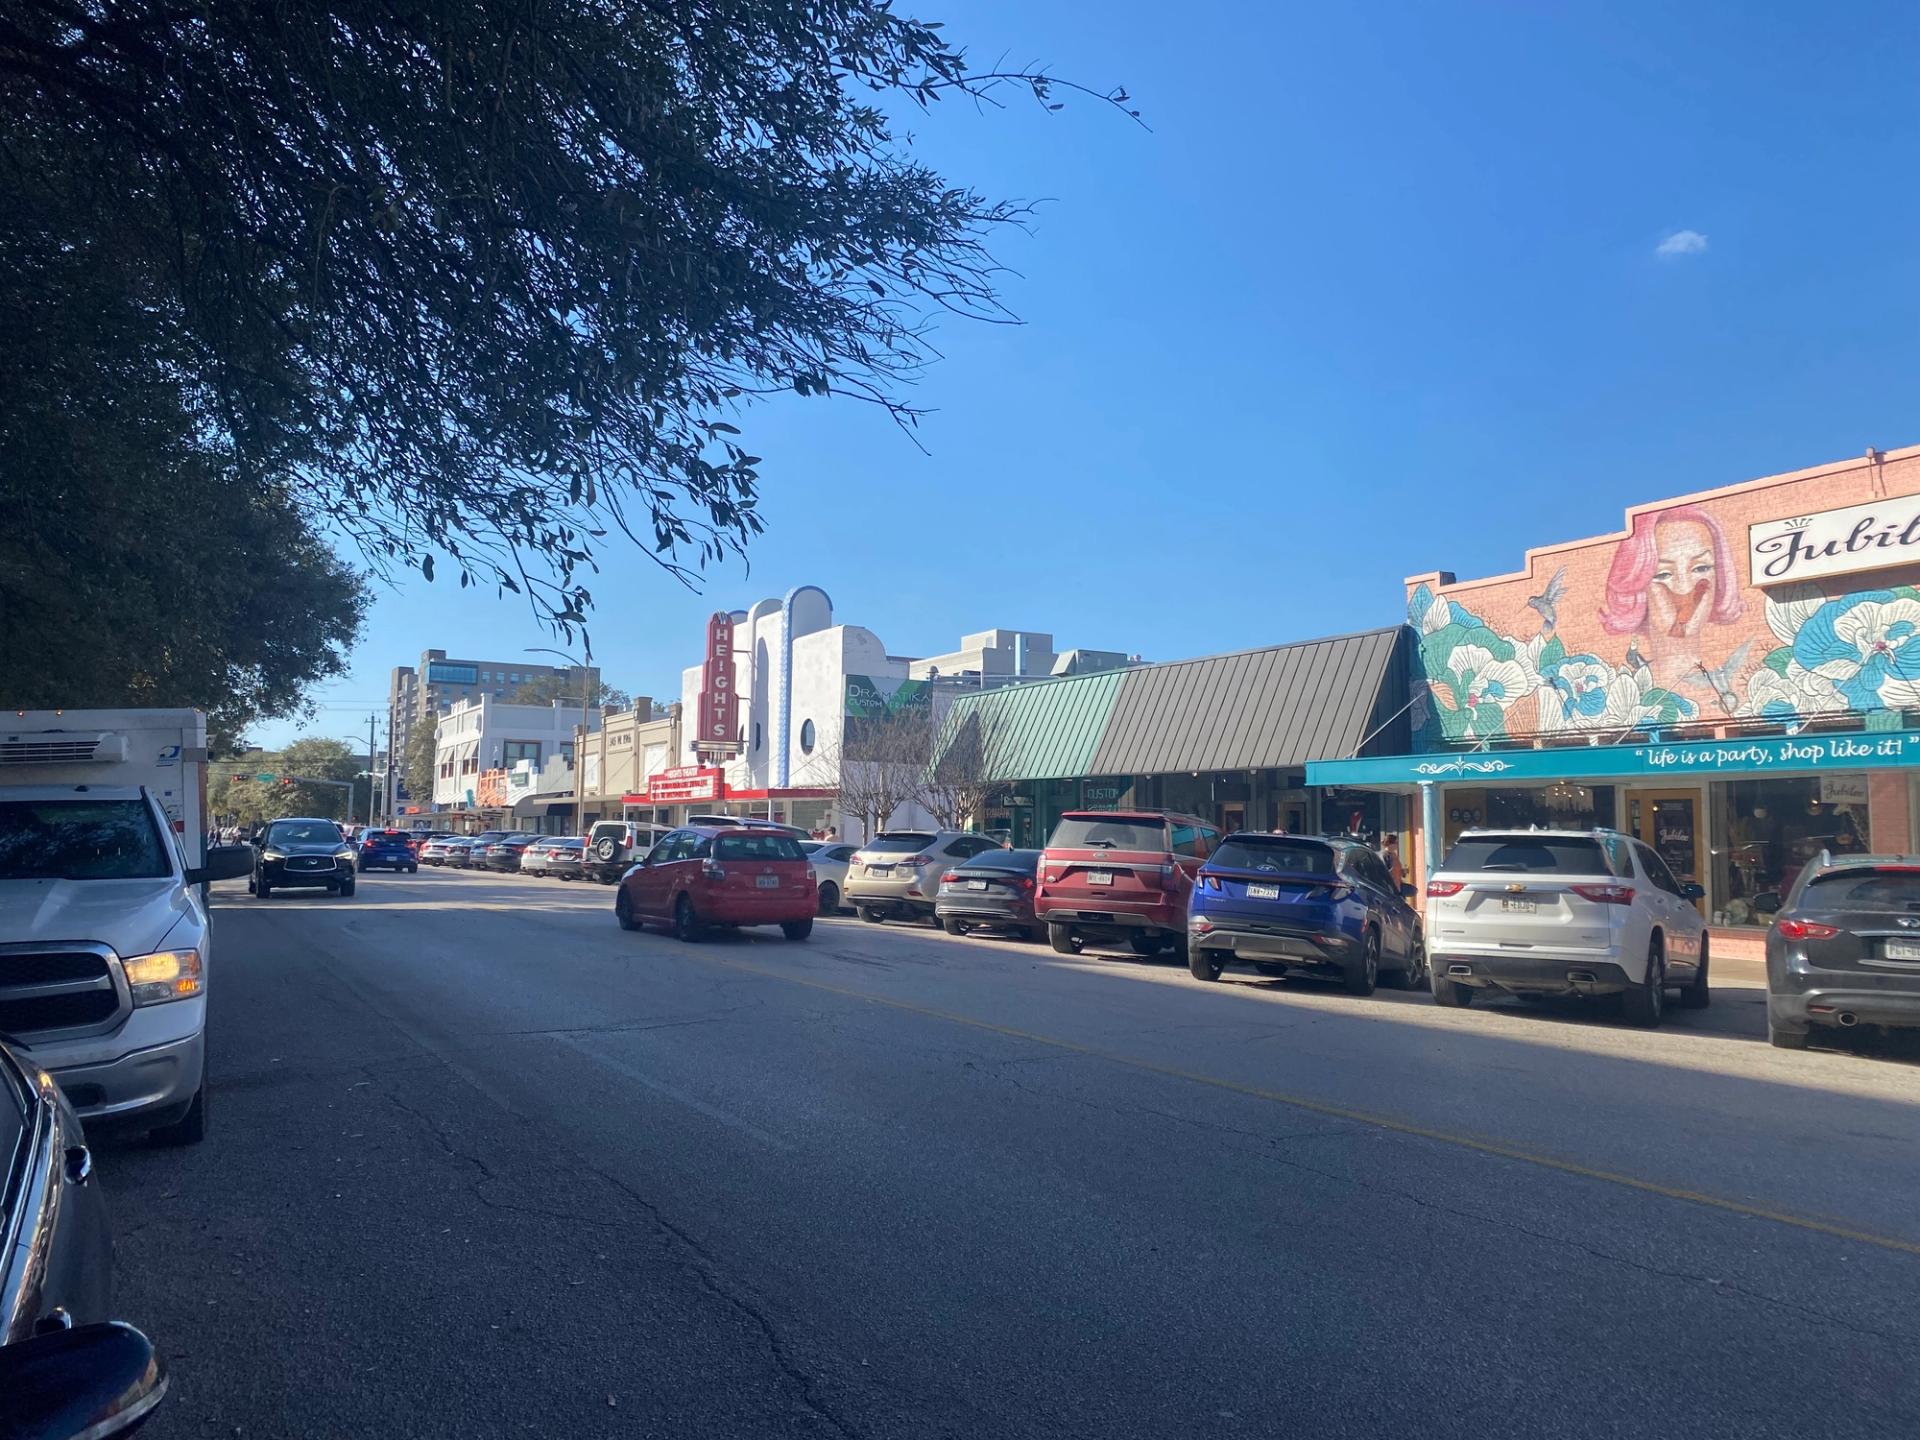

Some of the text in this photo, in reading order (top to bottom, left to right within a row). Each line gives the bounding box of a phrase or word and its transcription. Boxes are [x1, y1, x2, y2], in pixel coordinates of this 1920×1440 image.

[713, 628, 728, 737] HEIGHTS
[847, 698, 883, 708] CUSTOM
[1648, 749, 1678, 767] life
[1680, 750, 1697, 764] is
[1699, 751, 1715, 763] a
[1717, 745, 1773, 767] party,
[1780, 742, 1824, 763] shop
[1829, 740, 1873, 757] like
[1876, 740, 1902, 756] it!
